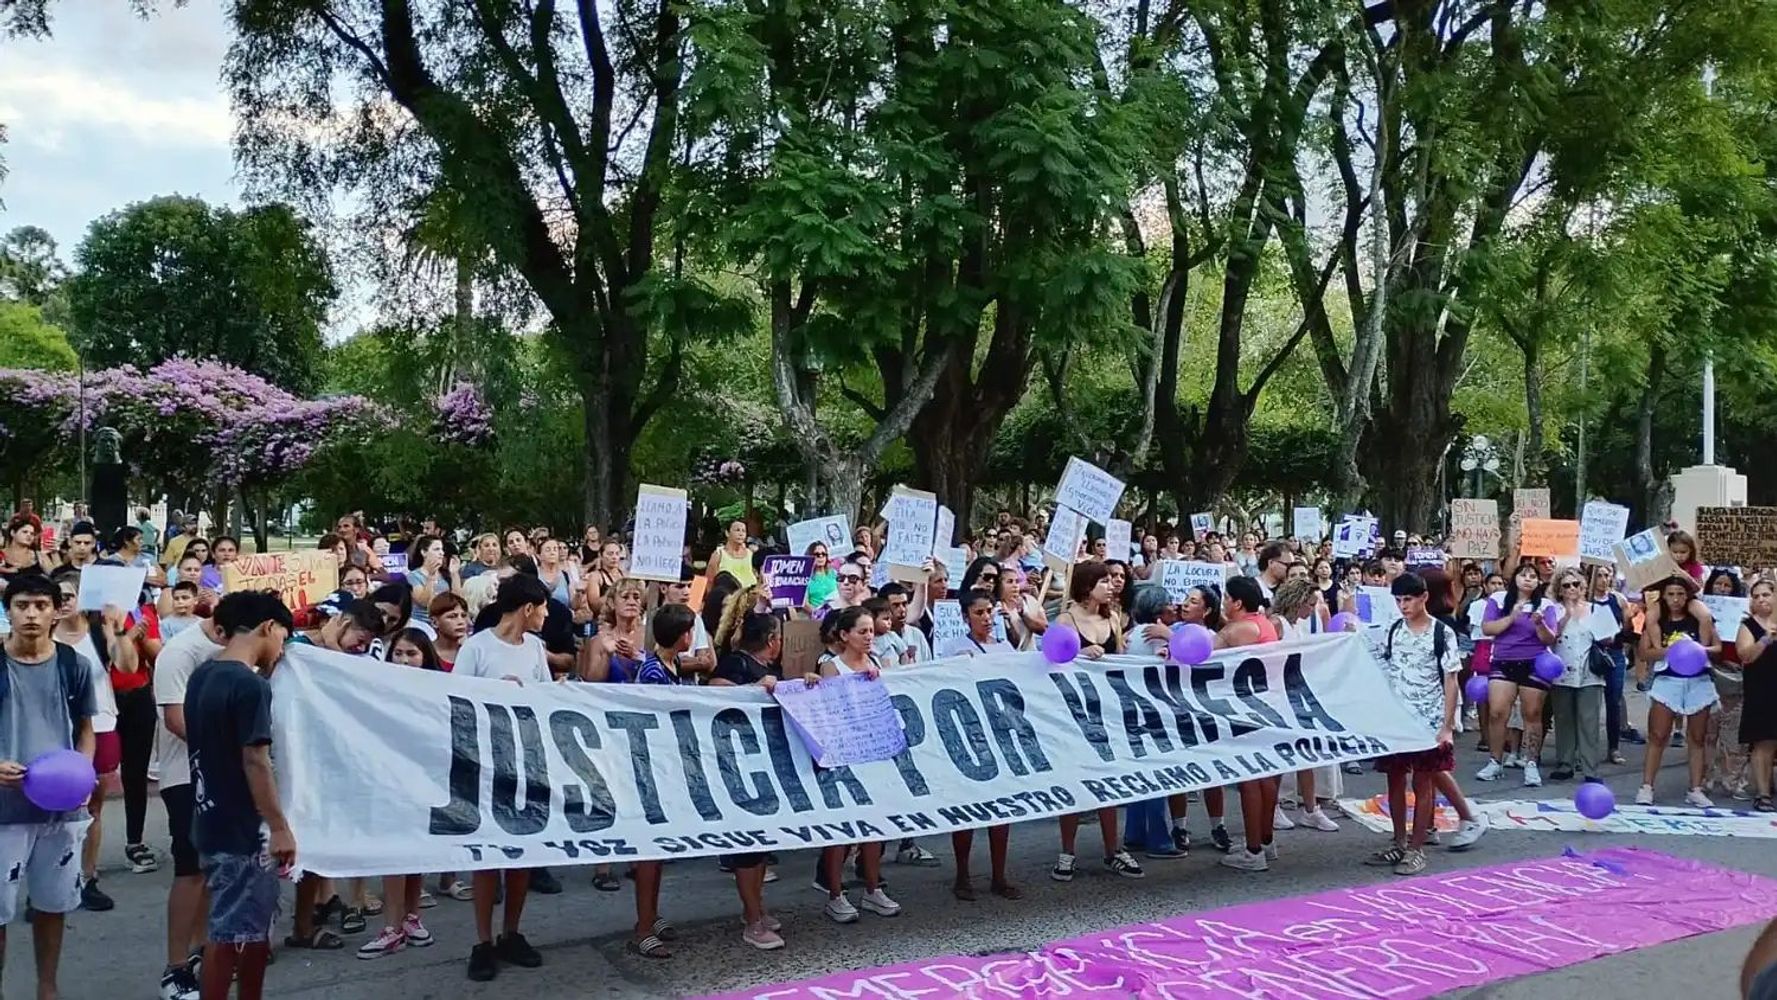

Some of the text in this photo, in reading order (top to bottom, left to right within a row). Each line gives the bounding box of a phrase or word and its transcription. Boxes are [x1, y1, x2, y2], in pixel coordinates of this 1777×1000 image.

[1454, 501, 1476, 513] SIN
[913, 522, 928, 532] NO
[1456, 528, 1472, 539] NO
[1467, 541, 1489, 554] PAZ
[771, 559, 806, 574] TOMEN
[1168, 563, 1220, 577] LA LOCURA
[1164, 578, 1177, 586] NO
[940, 607, 953, 617] SU
[888, 678, 1053, 797] POR
[1049, 653, 1346, 762] VANESA
[545, 839, 638, 858] VOZ
[652, 829, 780, 853] SIGUE
[779, 820, 885, 843] VIVA
[887, 811, 939, 833] EN
[937, 785, 1077, 826] NUESTRO
[1081, 762, 1208, 802] RECLAMO
[1211, 759, 1241, 779] A
[1234, 750, 1280, 775] LA
